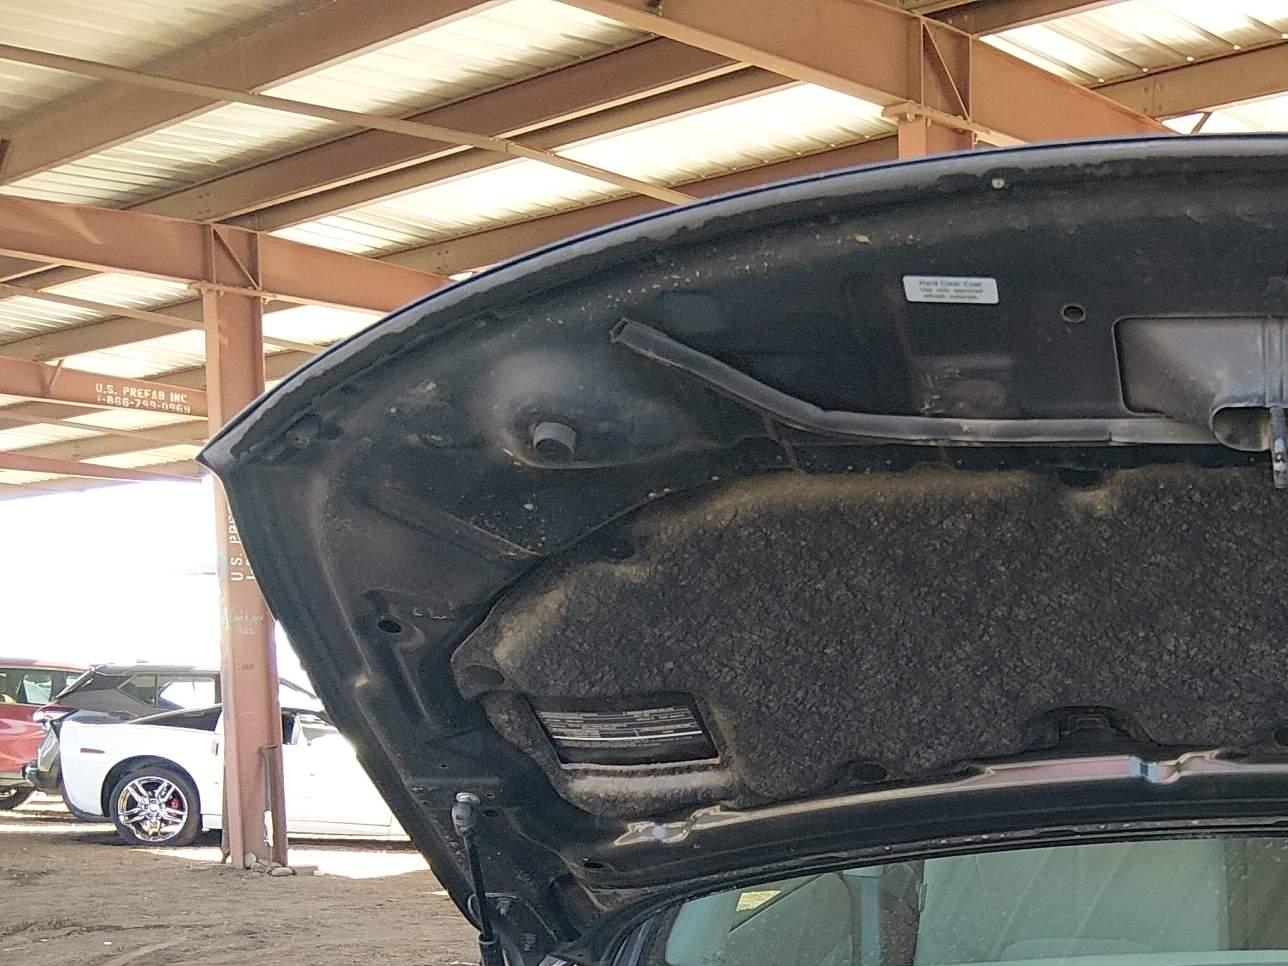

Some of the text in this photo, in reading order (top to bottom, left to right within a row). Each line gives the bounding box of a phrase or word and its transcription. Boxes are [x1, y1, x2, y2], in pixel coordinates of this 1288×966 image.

[95, 383, 188, 404] U.S. PREFAB INC
